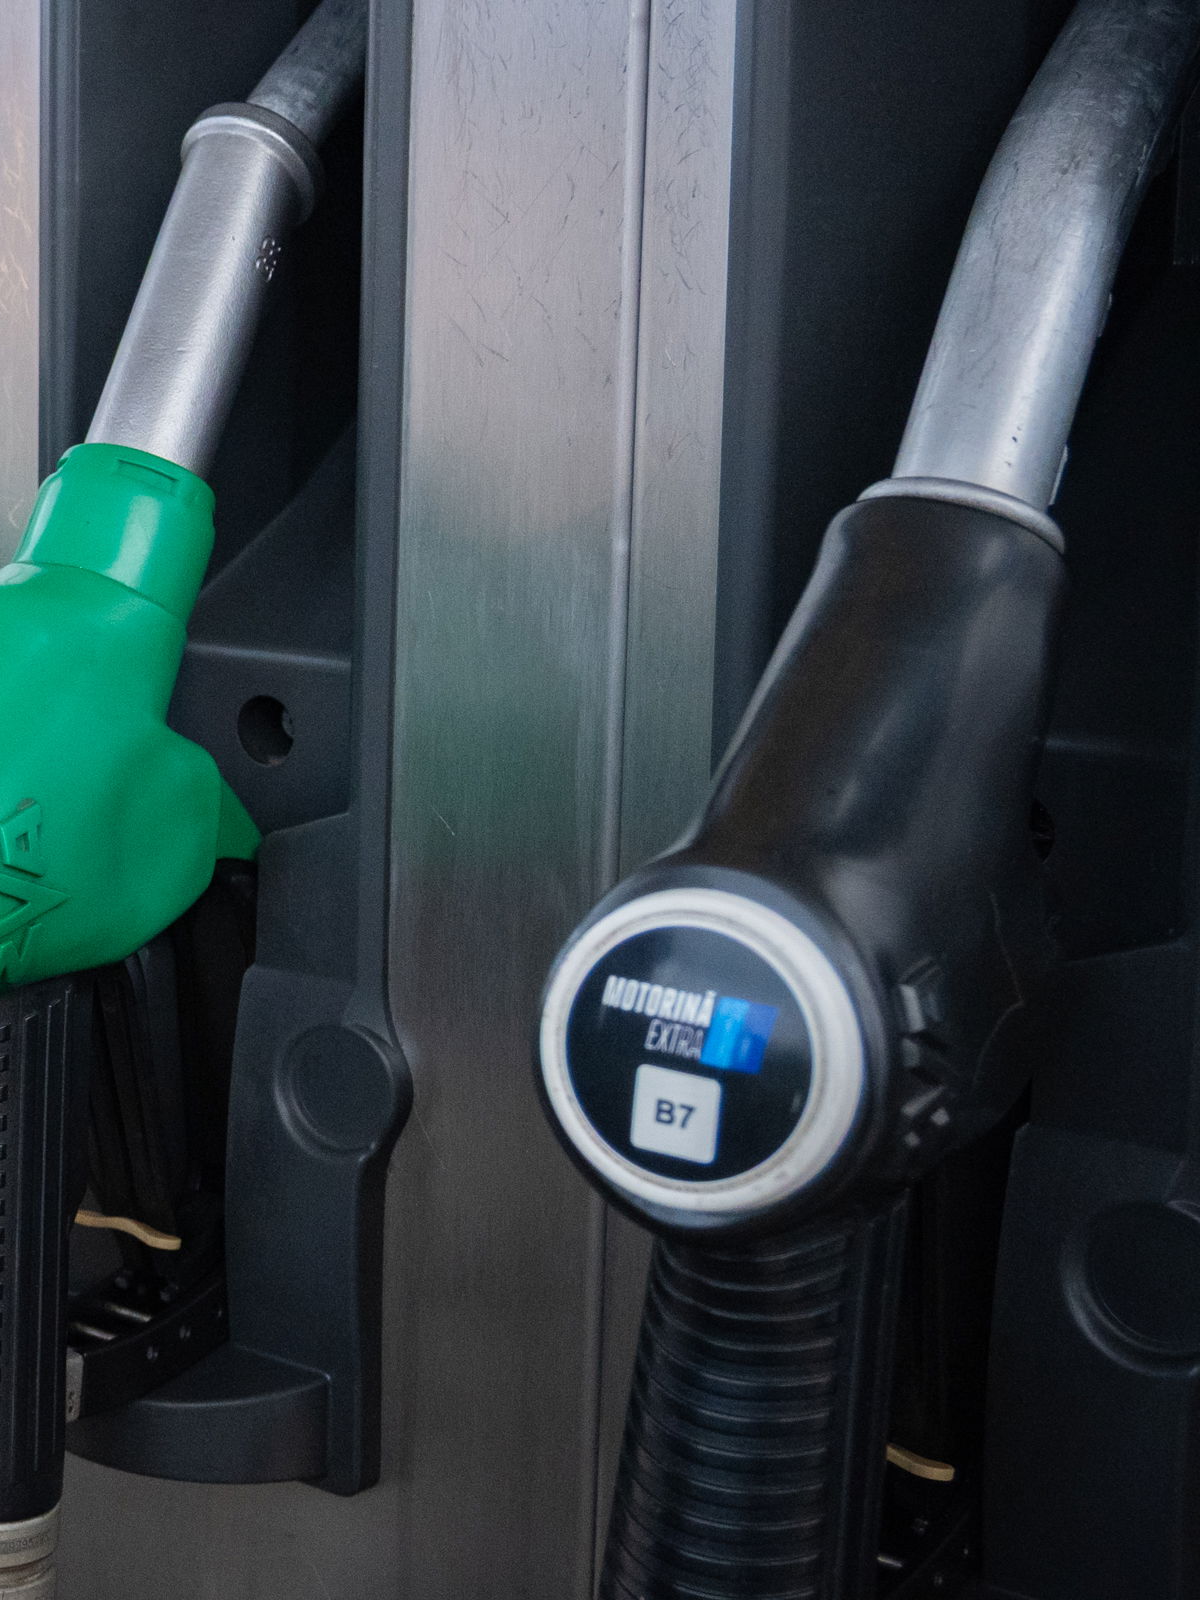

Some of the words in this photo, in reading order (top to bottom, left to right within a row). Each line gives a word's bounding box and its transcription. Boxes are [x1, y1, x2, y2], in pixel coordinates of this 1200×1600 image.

[601, 974, 717, 1028] MOTORINĂ
[644, 1017, 705, 1060] EXTRA
[654, 1099, 695, 1129] B7
